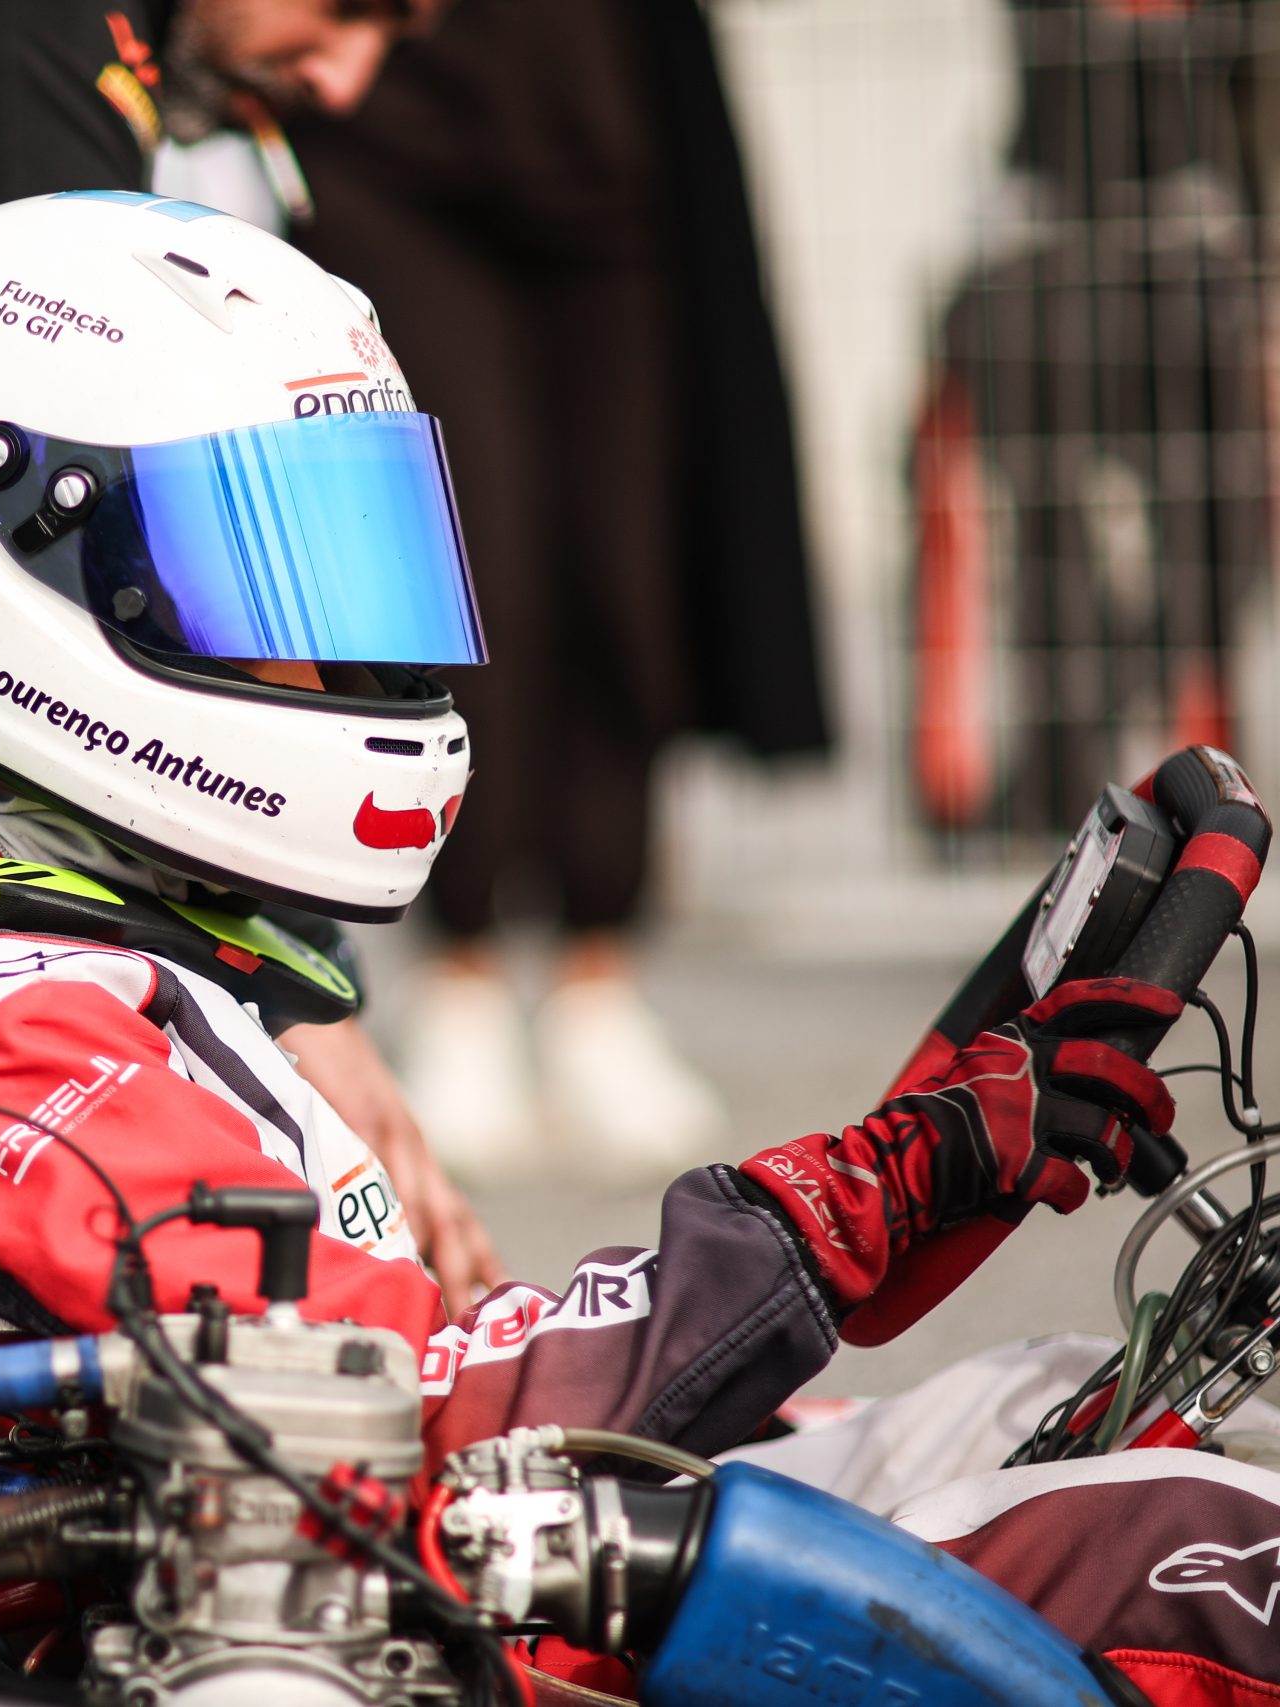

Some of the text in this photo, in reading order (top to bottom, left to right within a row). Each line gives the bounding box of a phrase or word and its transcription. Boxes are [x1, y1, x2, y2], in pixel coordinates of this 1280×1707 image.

[0, 280, 124, 343] Fundação
[26, 315, 64, 344] Gil
[131, 738, 287, 818] Antunes
